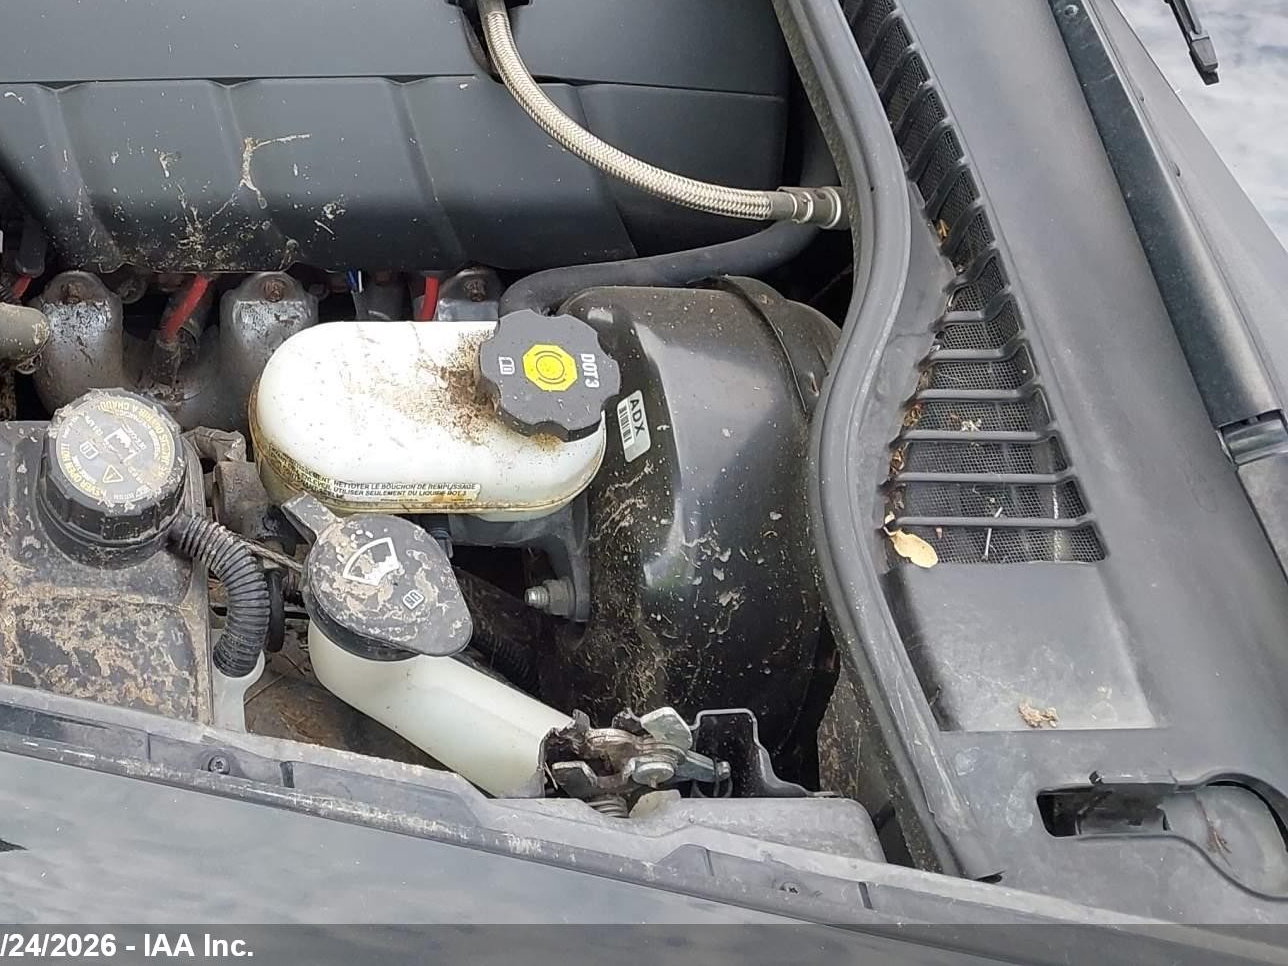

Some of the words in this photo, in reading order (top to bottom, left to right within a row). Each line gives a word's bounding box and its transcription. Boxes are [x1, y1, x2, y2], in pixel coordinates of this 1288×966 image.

[580, 353, 599, 378] DOT
[584, 377, 600, 388] 3
[629, 398, 646, 437] ADX
[64, 461, 83, 483] OPEN
[333, 480, 370, 490] NETTOYER
[381, 482, 416, 490] BOUCHON
[417, 482, 426, 490] DE
[333, 487, 365, 496] UTILISER
